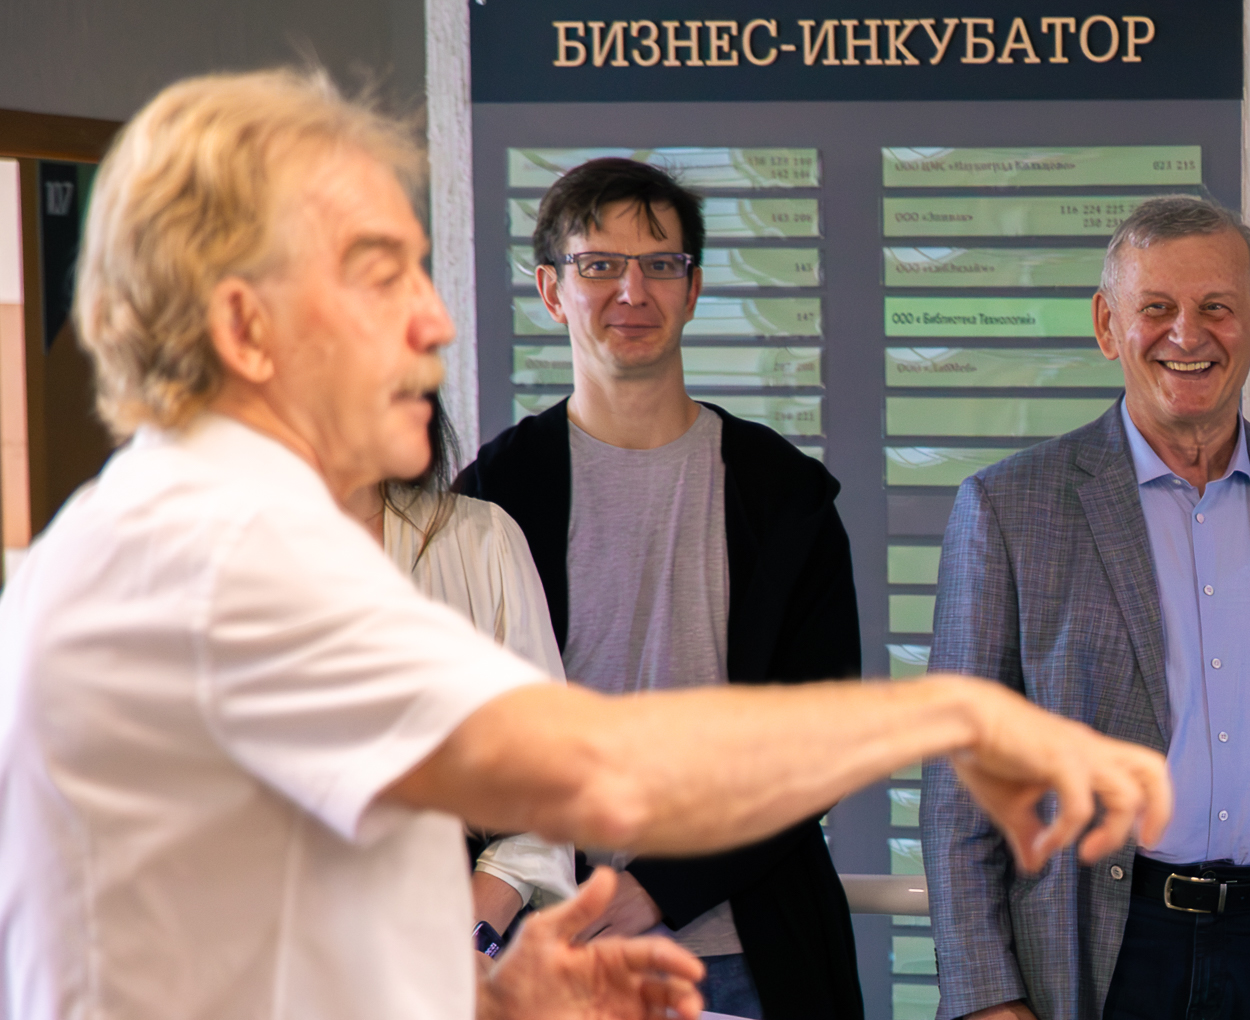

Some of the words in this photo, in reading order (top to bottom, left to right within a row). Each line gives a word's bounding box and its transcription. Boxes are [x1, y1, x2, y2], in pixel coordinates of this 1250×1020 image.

[551, 15, 1157, 68] БИЗНЕС-ИНКУБАТОР
[894, 211, 920, 223] ООО
[891, 311, 915, 325] ООО
